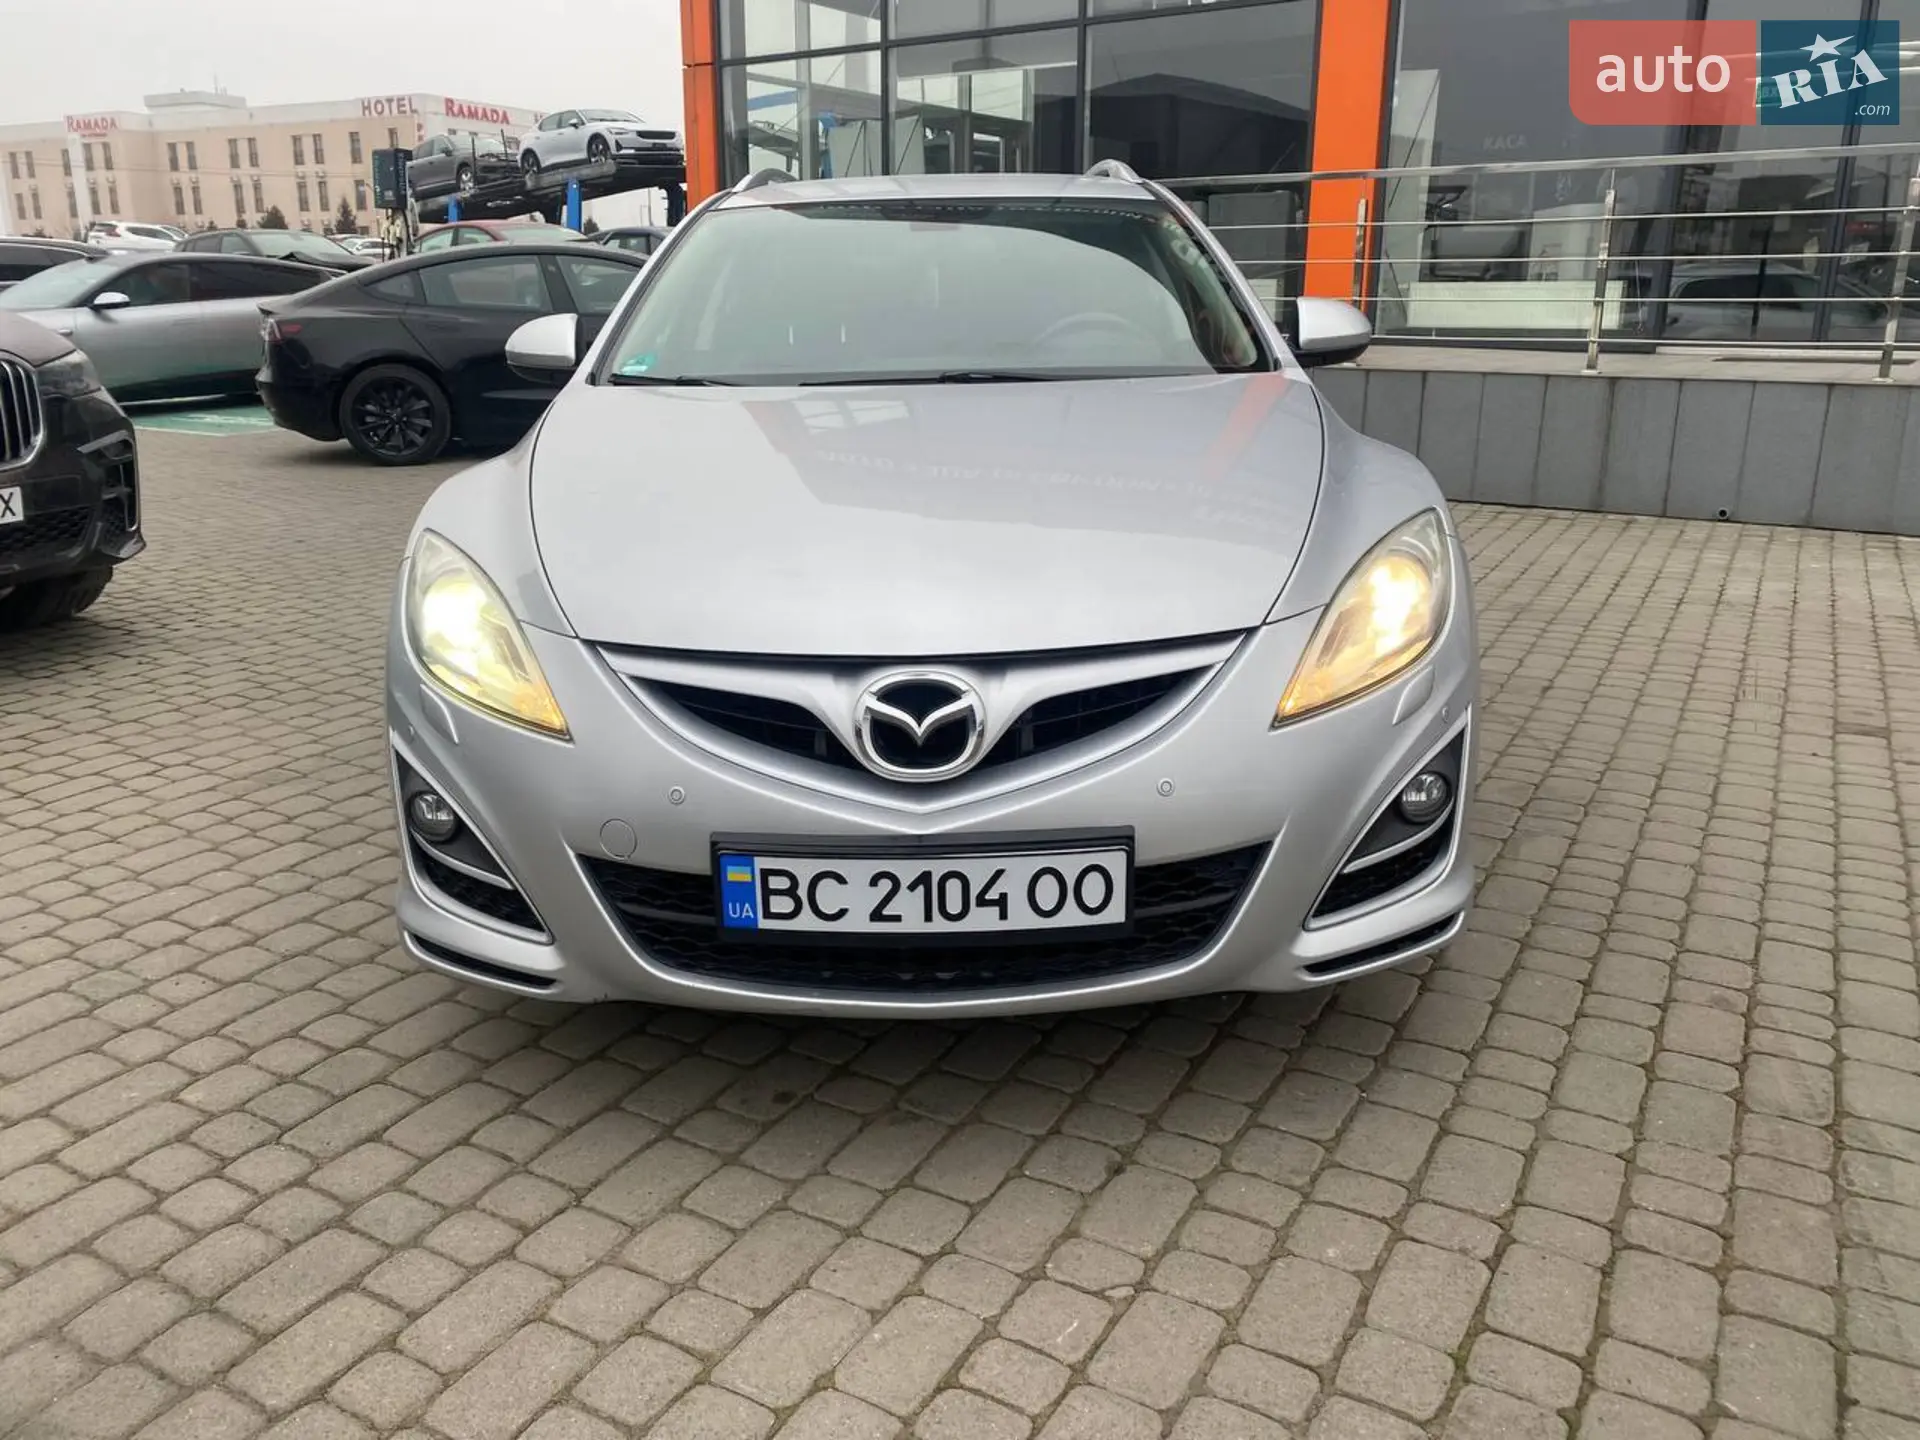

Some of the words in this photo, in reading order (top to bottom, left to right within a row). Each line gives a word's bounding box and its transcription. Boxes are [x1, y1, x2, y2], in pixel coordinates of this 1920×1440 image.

[361, 96, 419, 116] HOTEL
[444, 97, 511, 126] RAMADA
[66, 115, 119, 133] RAMADA
[760, 868, 850, 922] BC
[869, 868, 1009, 923] 2104
[1027, 863, 1114, 919] OO
[728, 902, 755, 920] UA
